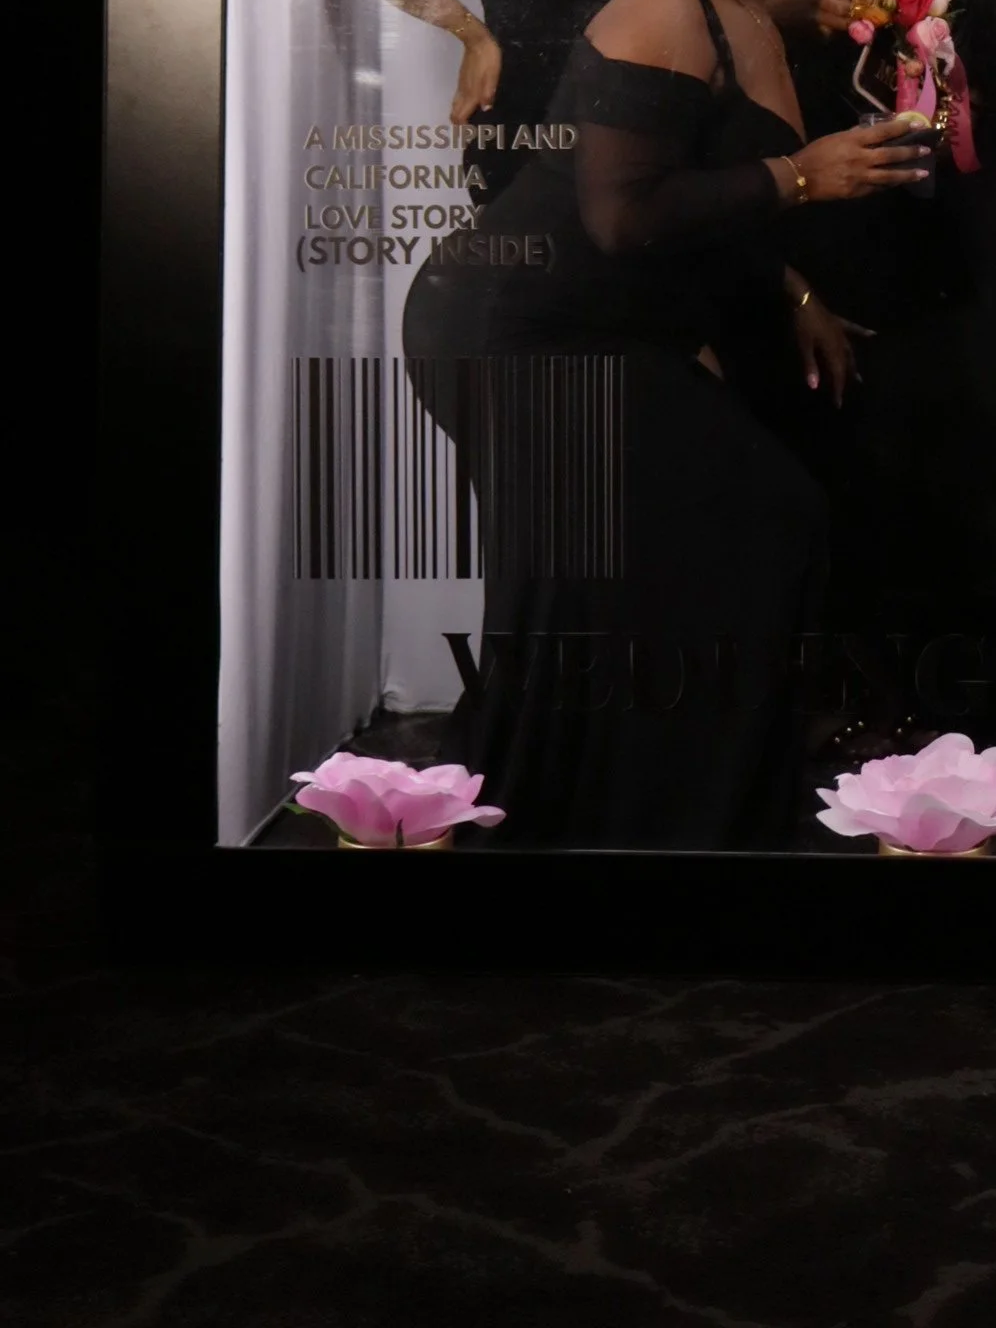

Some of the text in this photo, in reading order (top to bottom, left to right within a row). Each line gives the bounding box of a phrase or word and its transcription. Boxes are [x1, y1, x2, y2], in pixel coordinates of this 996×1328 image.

[302, 122, 580, 152] A MISSISSIPPI AND
[303, 163, 488, 191] CALIFORNIA
[304, 203, 487, 231] LOVE STORY
[295, 232, 558, 273] (STORY INSIDE)
